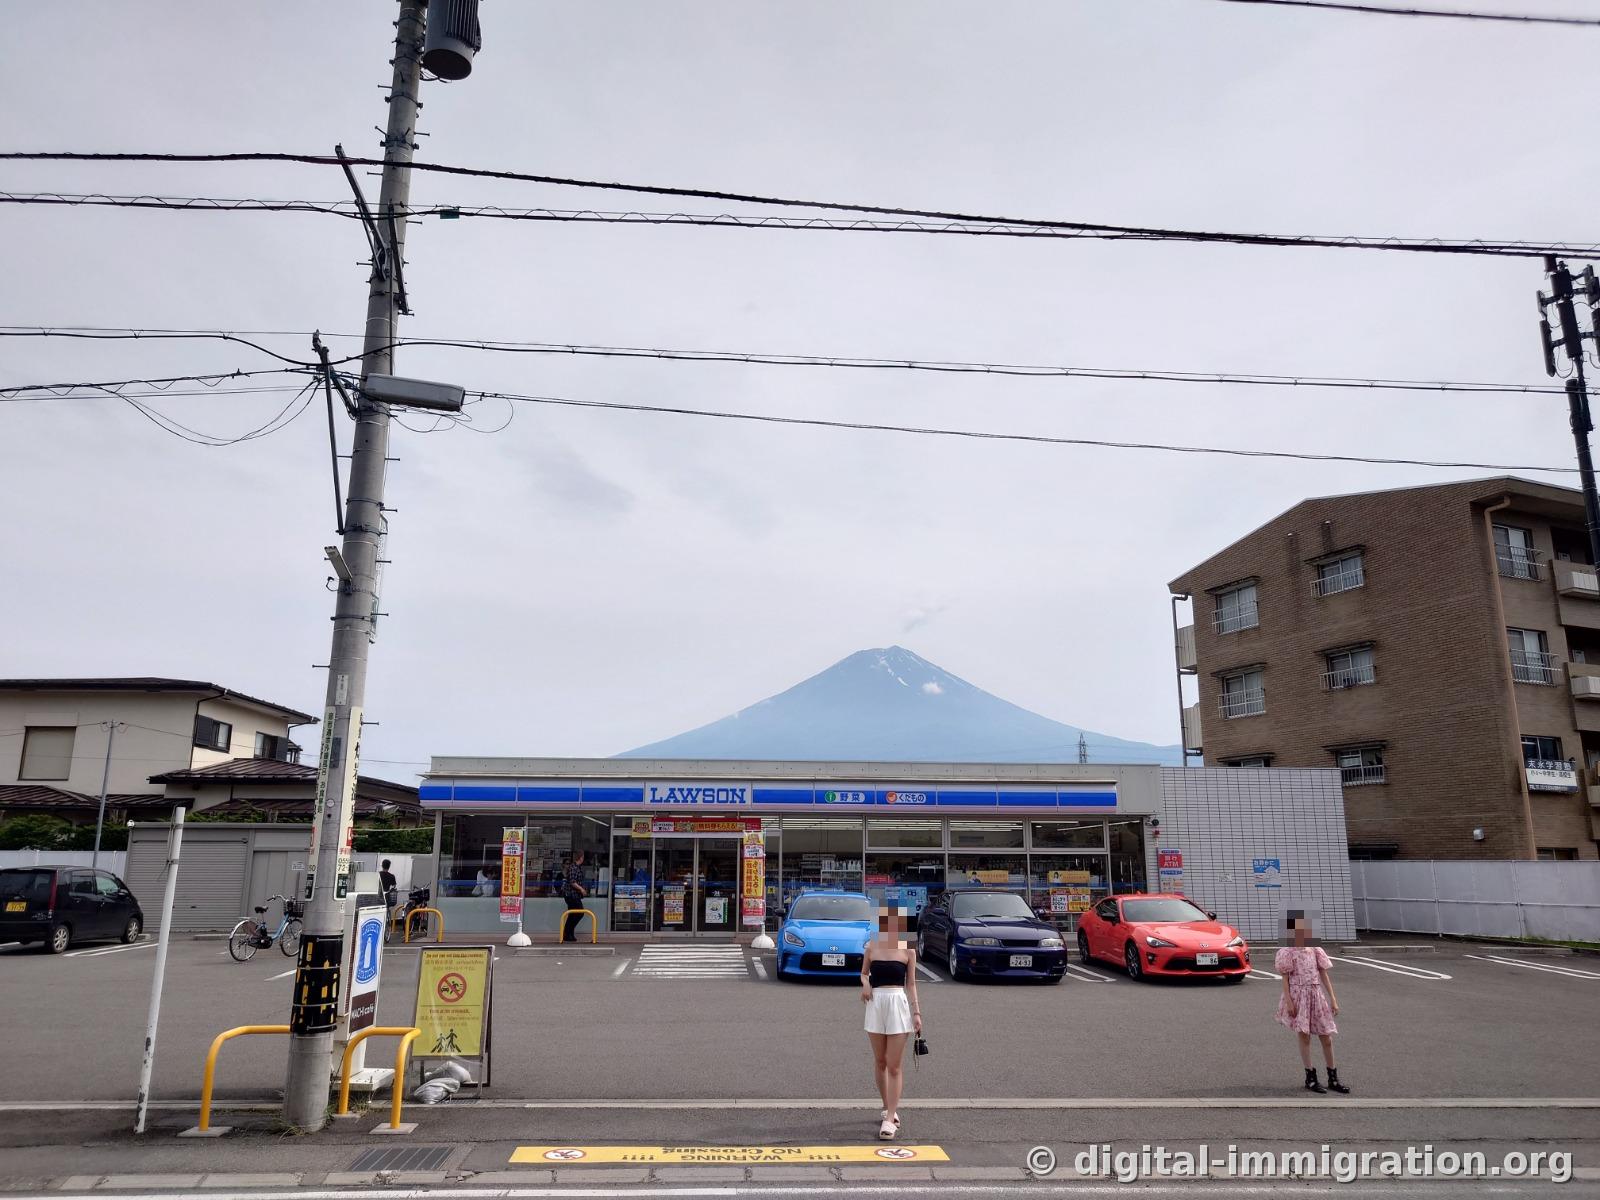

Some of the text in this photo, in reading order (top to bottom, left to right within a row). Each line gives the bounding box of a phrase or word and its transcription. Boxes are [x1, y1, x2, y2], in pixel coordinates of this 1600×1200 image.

[650, 787, 746, 803] LAWSON
[839, 792, 860, 802] 野菜
[898, 792, 925, 802] くだもの
